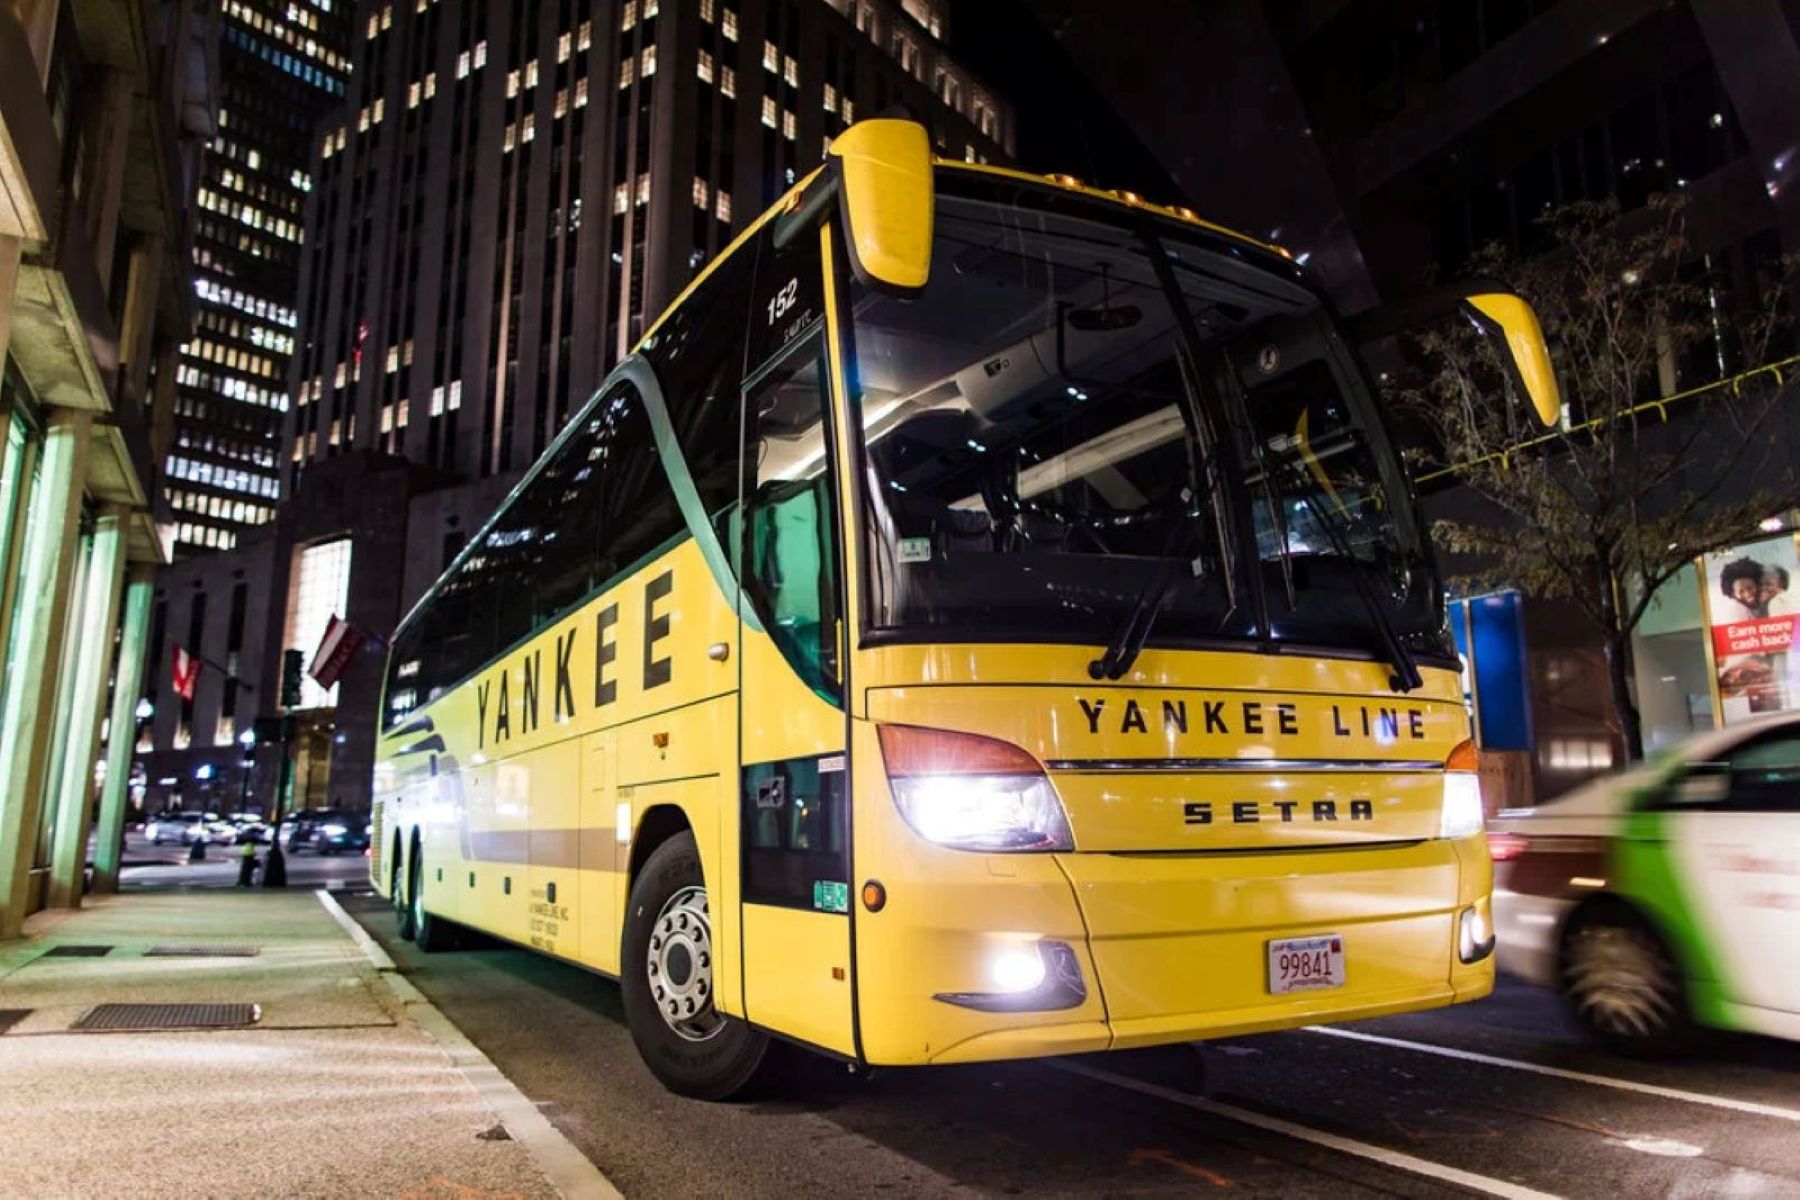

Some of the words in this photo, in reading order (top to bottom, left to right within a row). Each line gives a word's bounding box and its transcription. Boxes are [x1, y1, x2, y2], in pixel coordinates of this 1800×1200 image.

[767, 277, 798, 326] 152
[1727, 625, 1756, 639] Earn
[1759, 621, 1792, 634] more
[1731, 637, 1760, 650] cash
[477, 569, 673, 750] YANKEE
[1078, 698, 1299, 735] YANKEE
[1332, 705, 1425, 739] LINE
[1183, 799, 1373, 824] SETRA
[1279, 950, 1332, 980] 99841
